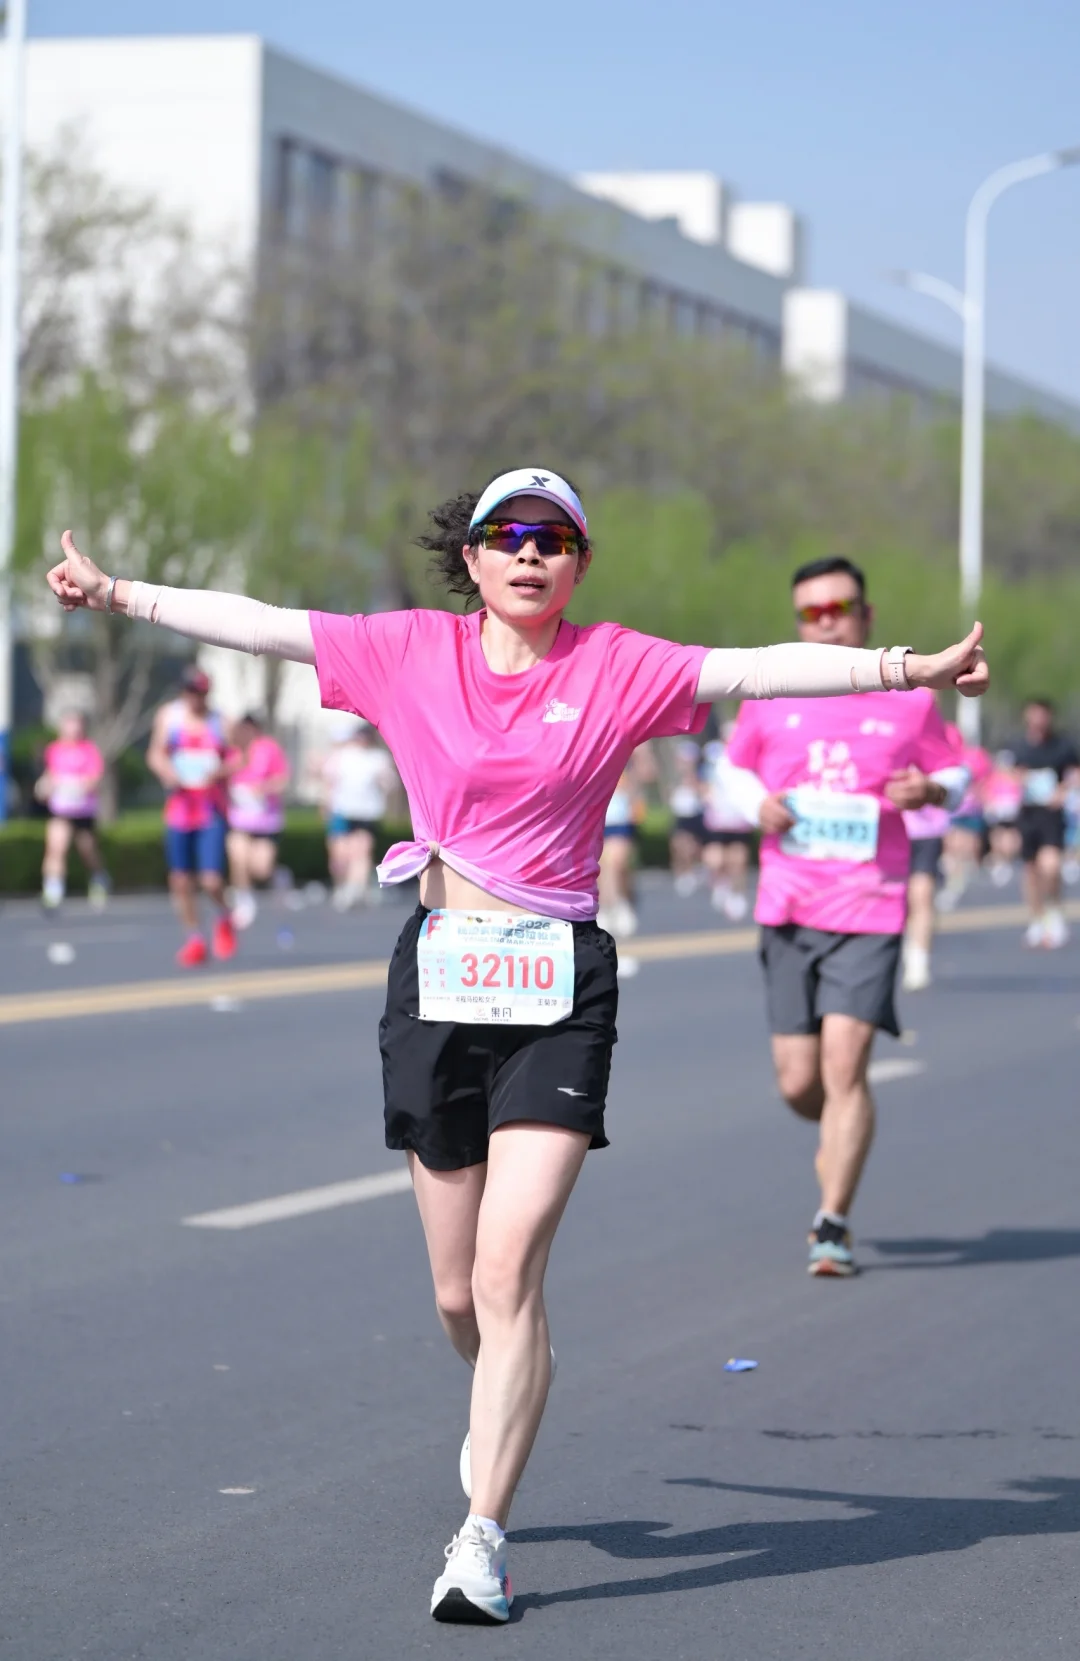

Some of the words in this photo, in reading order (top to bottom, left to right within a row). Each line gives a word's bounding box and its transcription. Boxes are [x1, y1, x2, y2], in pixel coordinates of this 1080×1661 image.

[427, 916, 444, 940] F
[516, 919, 551, 930] 2026
[460, 952, 555, 990] 32110
